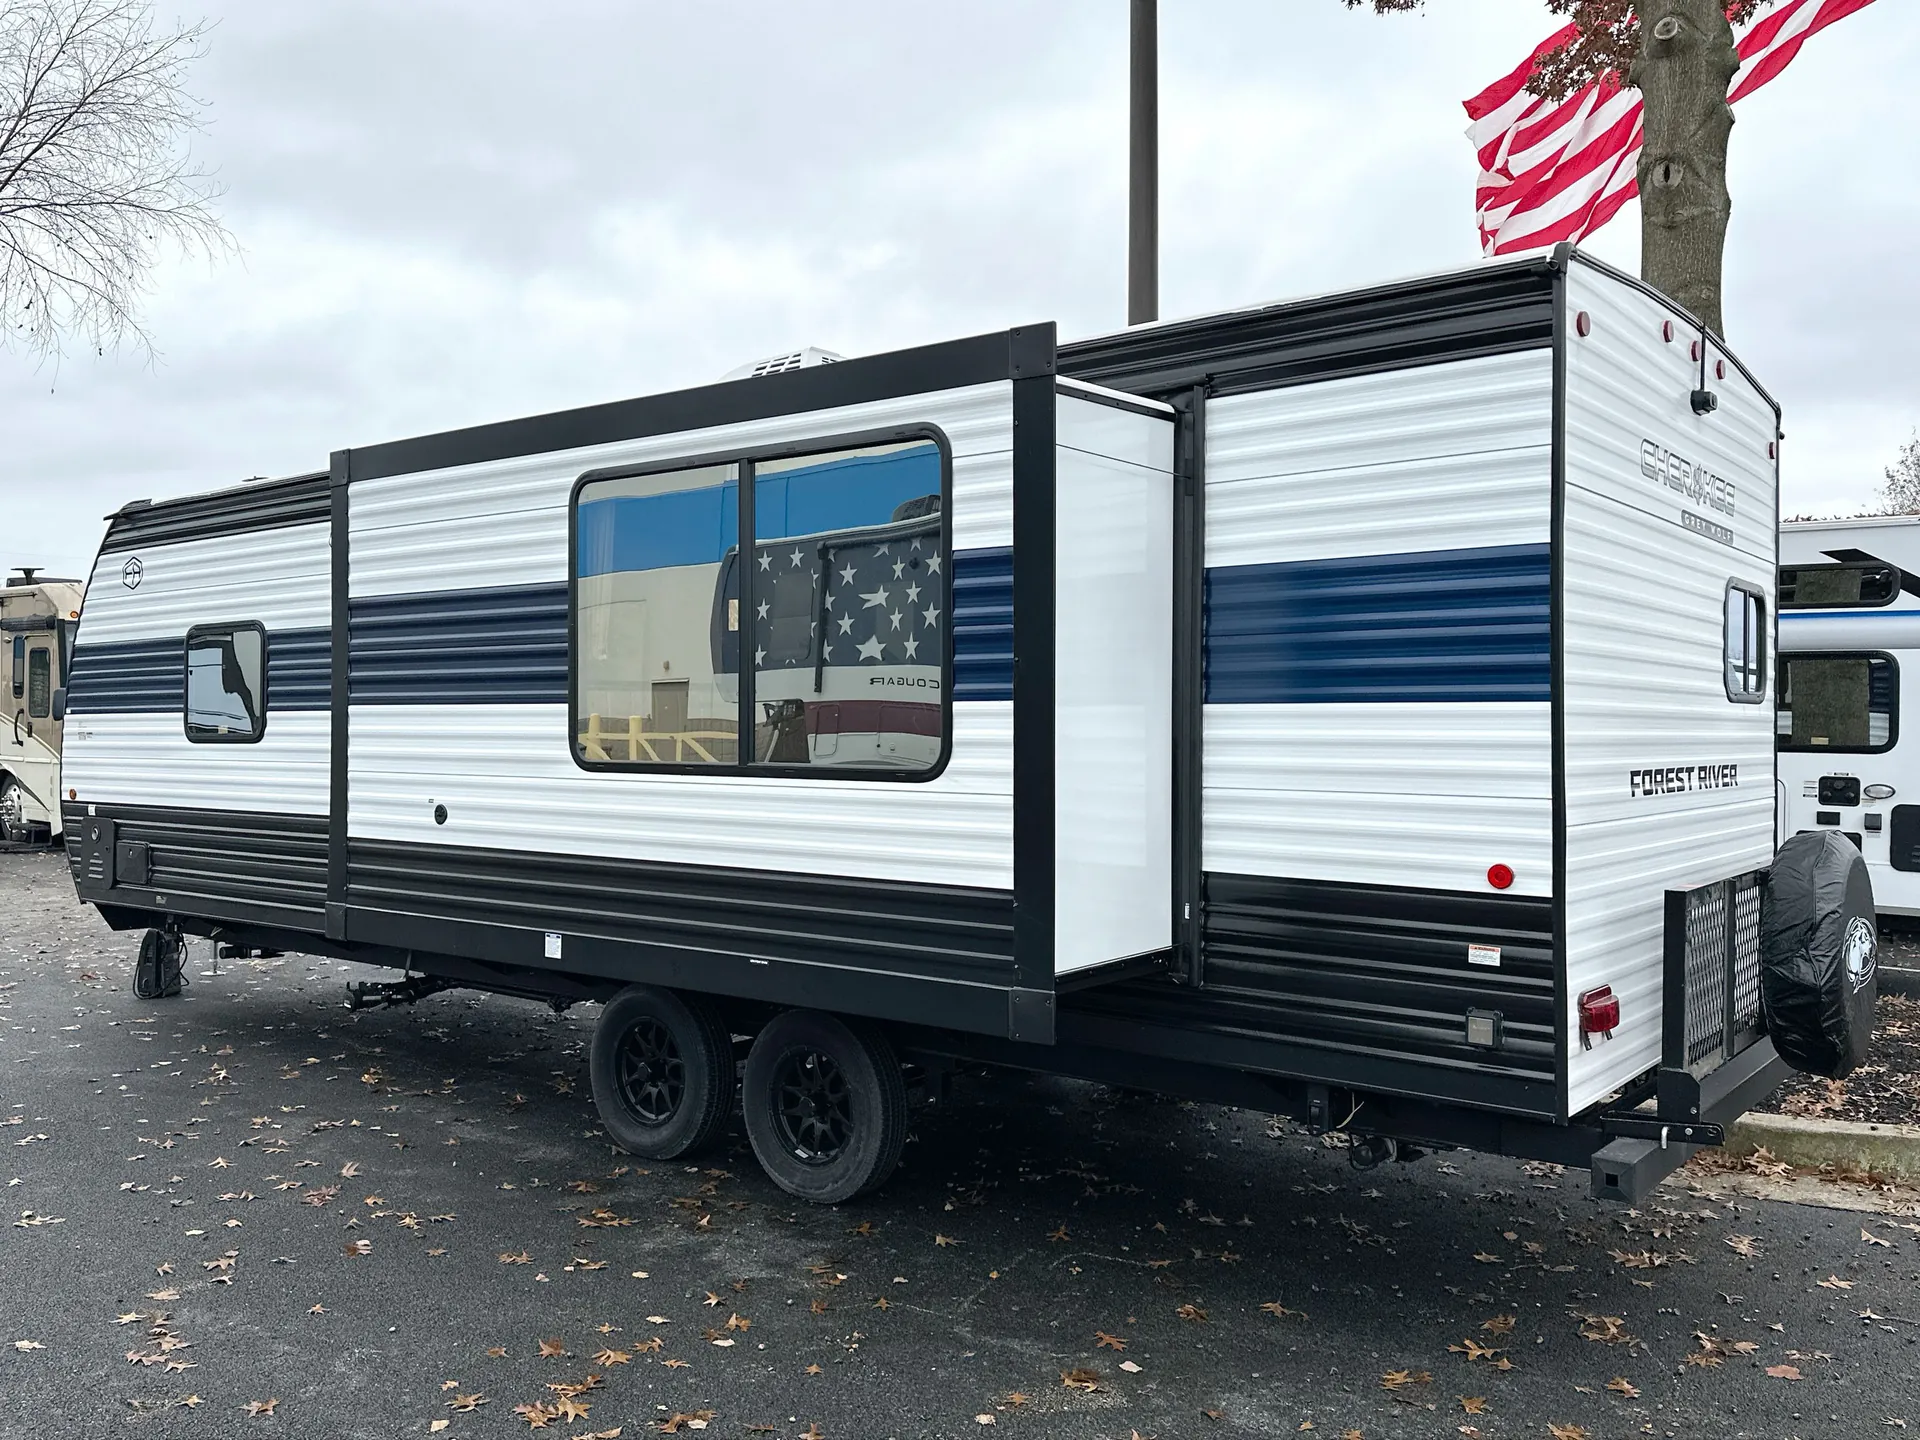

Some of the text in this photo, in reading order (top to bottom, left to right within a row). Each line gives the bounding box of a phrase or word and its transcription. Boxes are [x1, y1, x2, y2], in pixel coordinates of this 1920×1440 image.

[1684, 514, 1706, 531] GREY
[1630, 764, 1738, 797] FOREST RIVER
